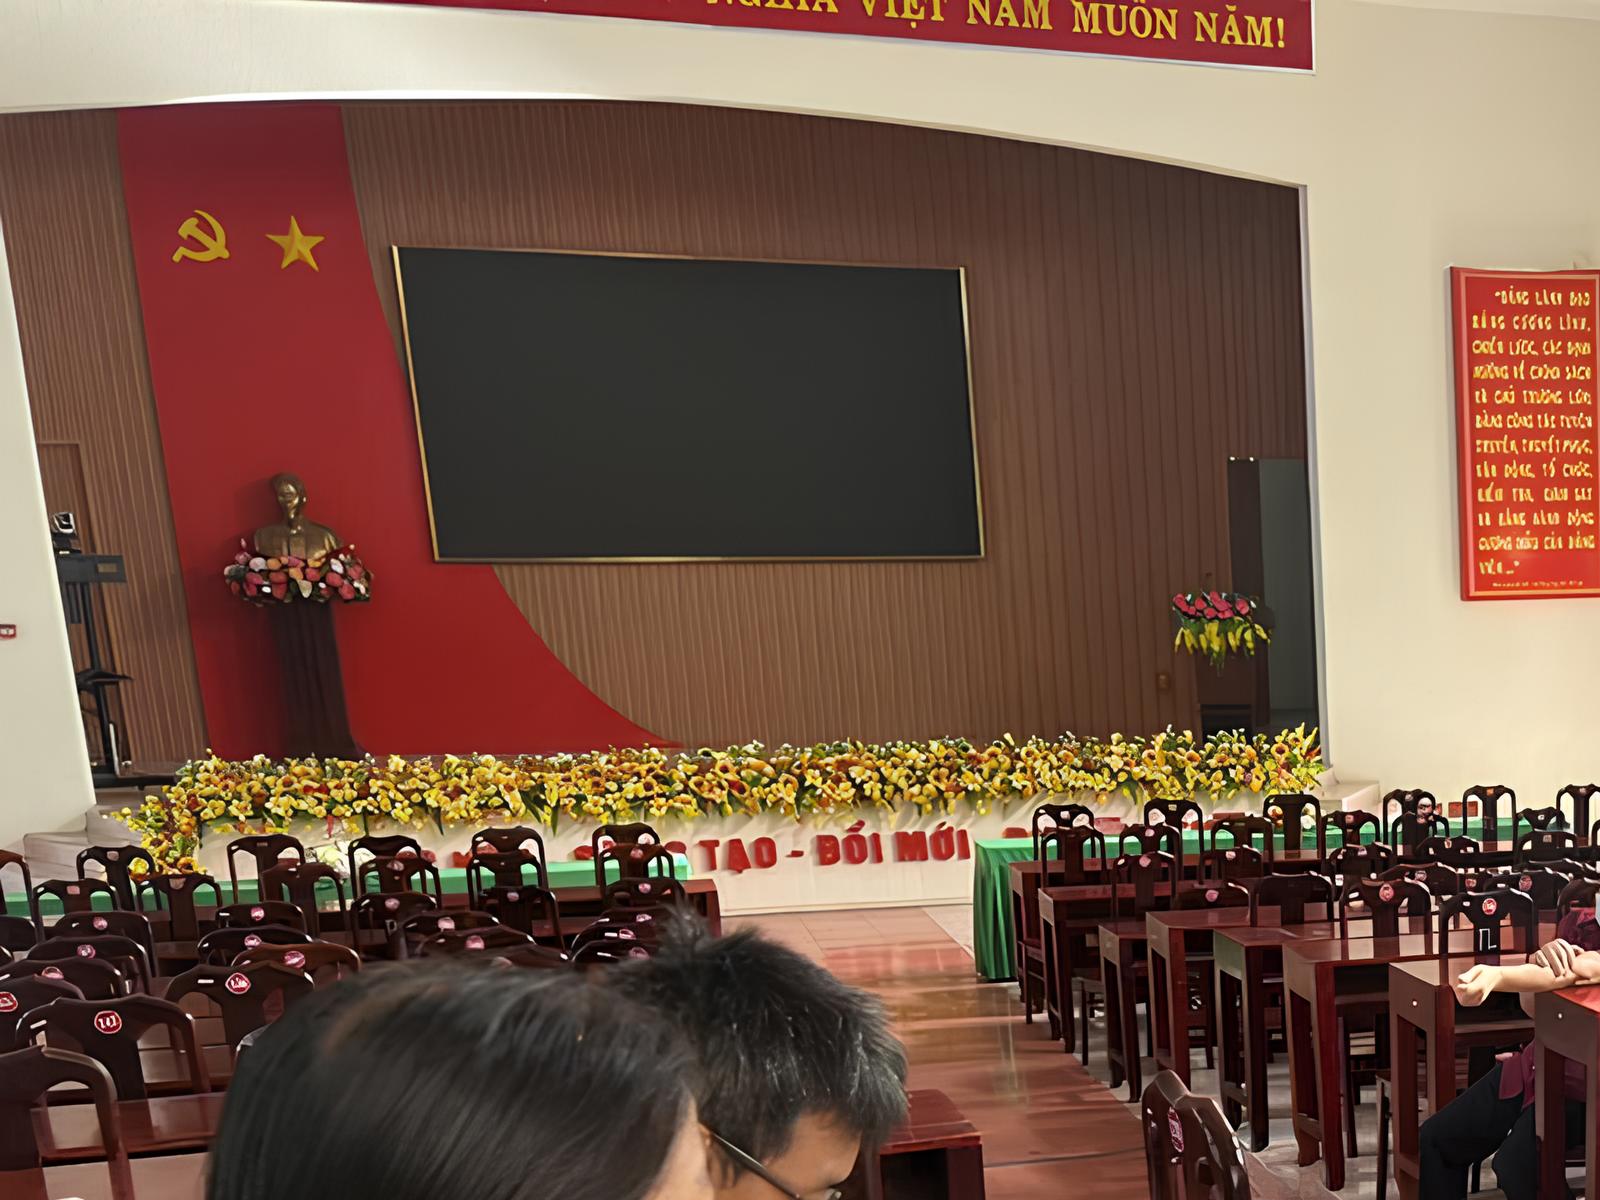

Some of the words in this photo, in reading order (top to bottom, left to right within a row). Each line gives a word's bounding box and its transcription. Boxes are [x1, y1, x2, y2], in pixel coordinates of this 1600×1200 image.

[963, 0, 1053, 30] NAM
[1194, 4, 1285, 48] NĂM!
[699, 837, 777, 873] TẠO
[817, 821, 883, 866] ĐỔI
[894, 821, 971, 862] MỚI
